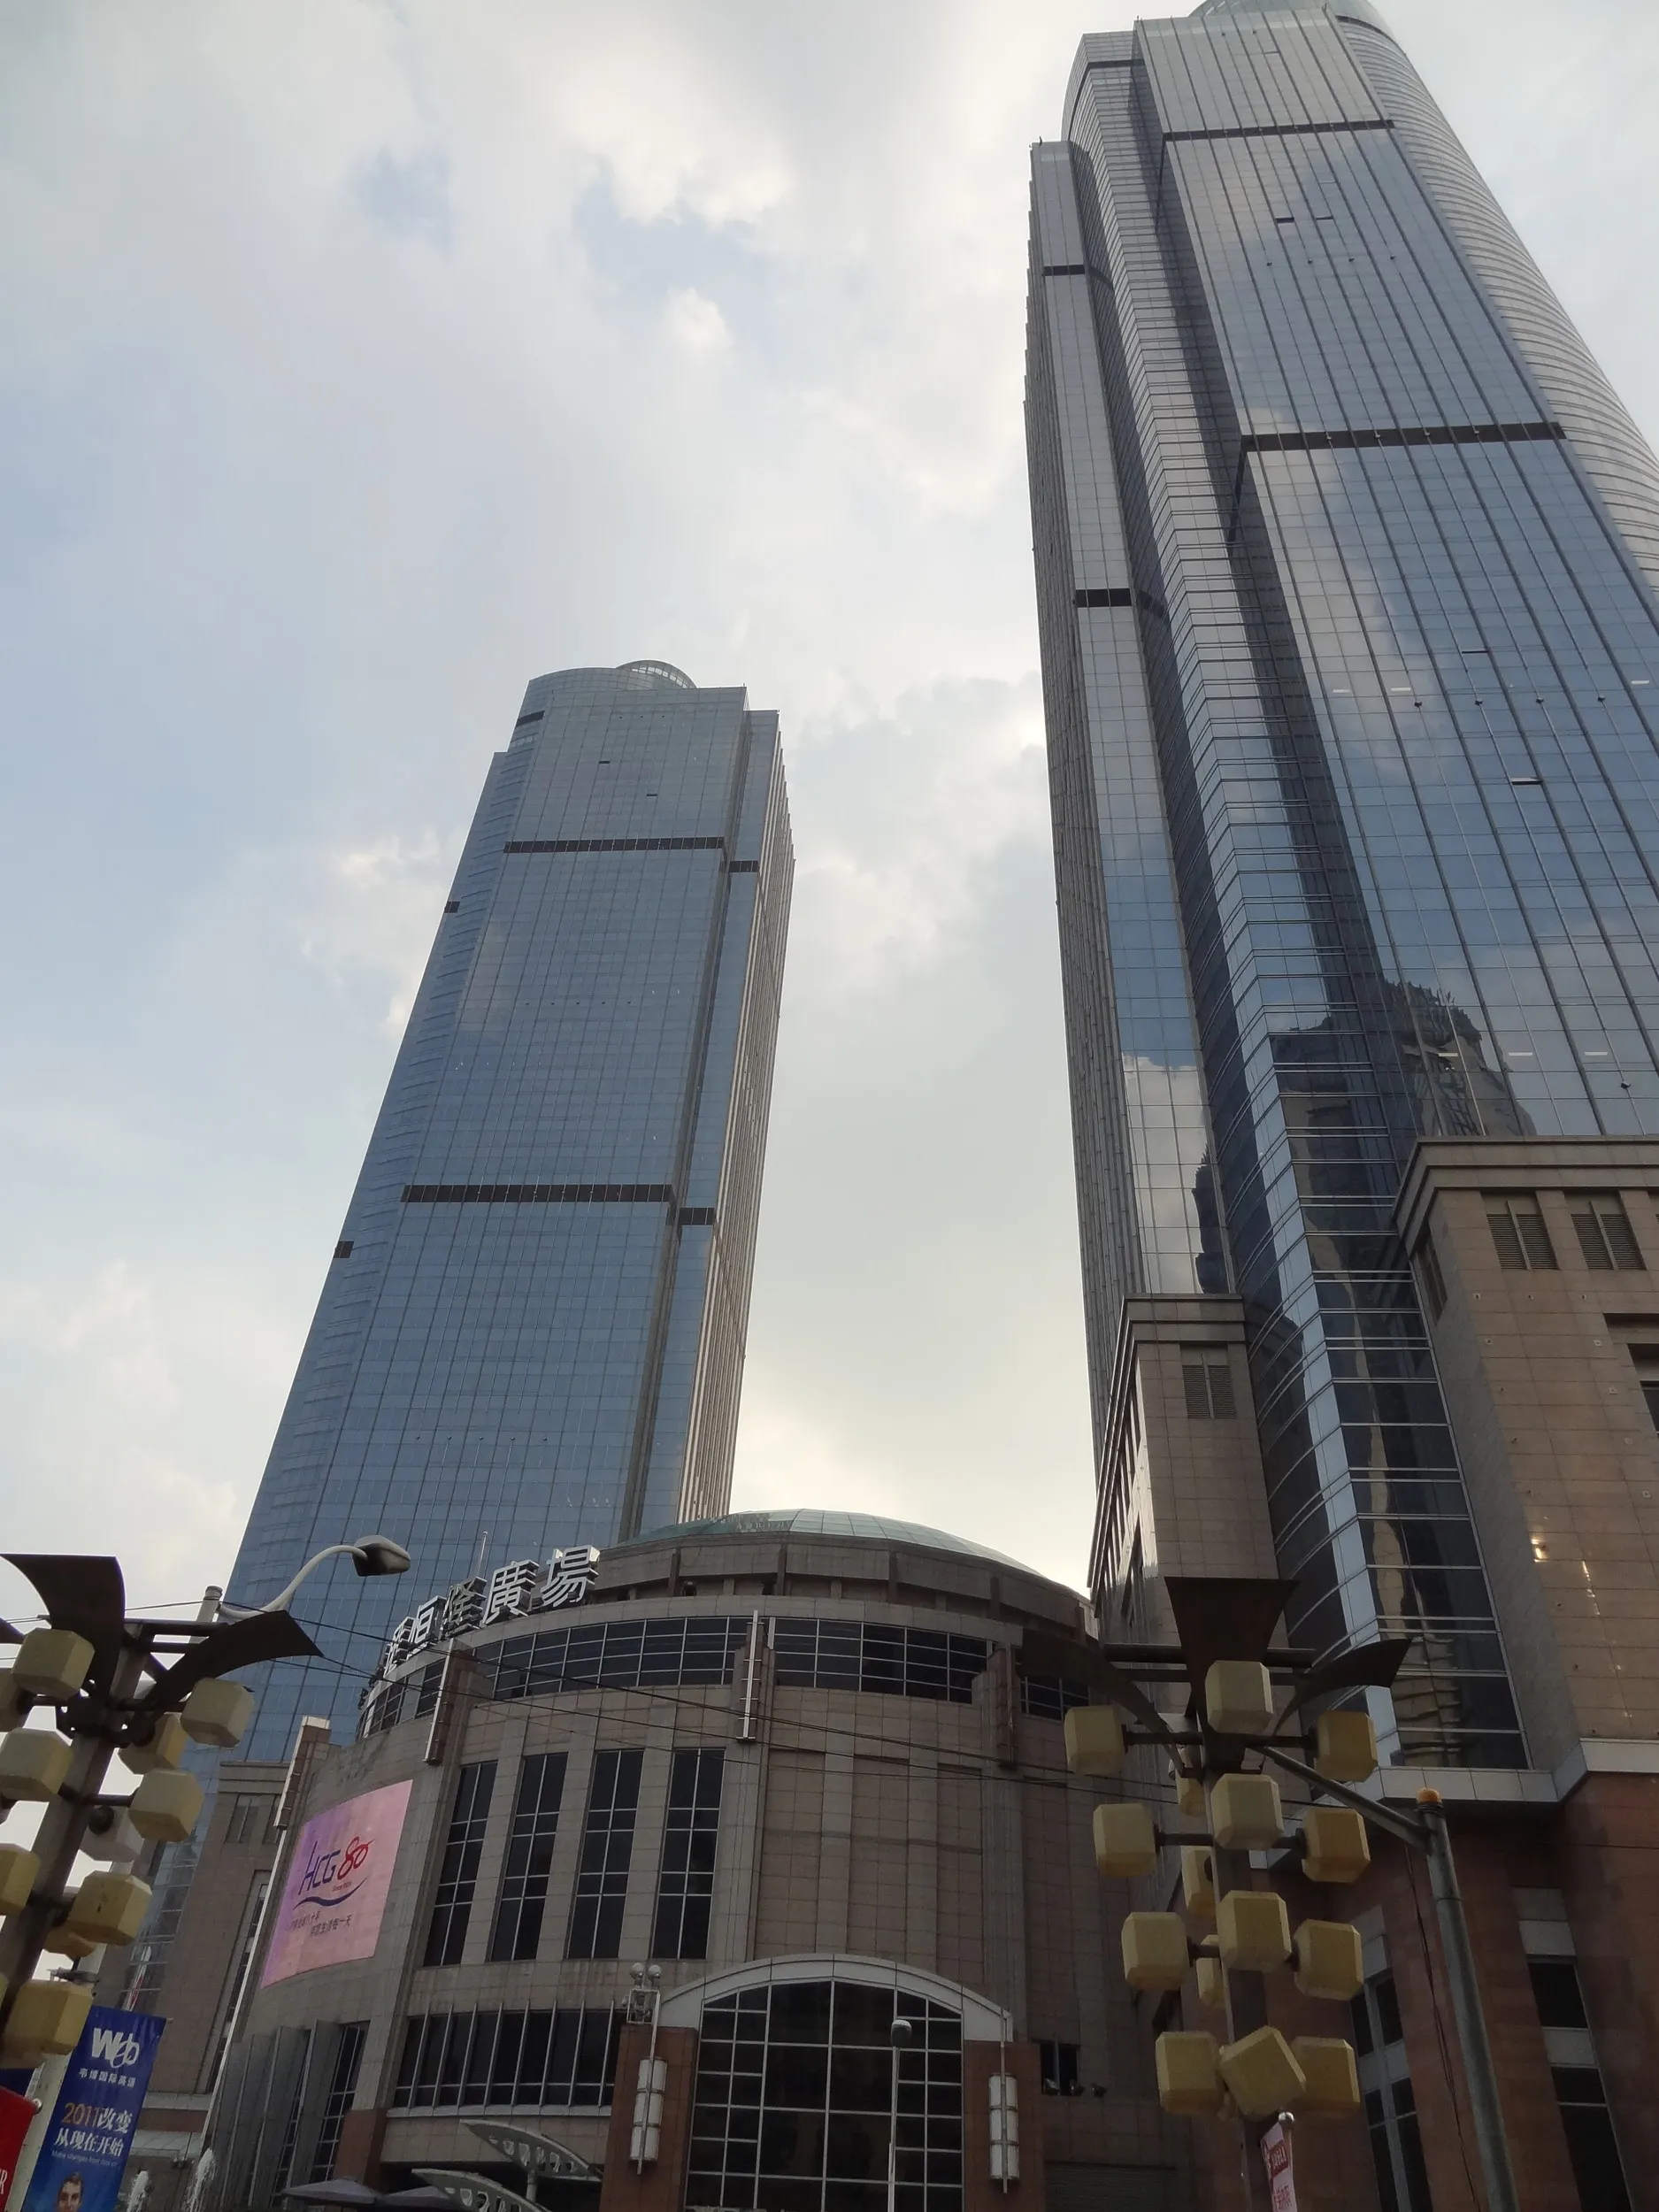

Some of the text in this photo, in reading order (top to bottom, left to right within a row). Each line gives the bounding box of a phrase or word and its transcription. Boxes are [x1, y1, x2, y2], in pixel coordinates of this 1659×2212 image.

[53, 2127, 125, 2158] 从现在开始
